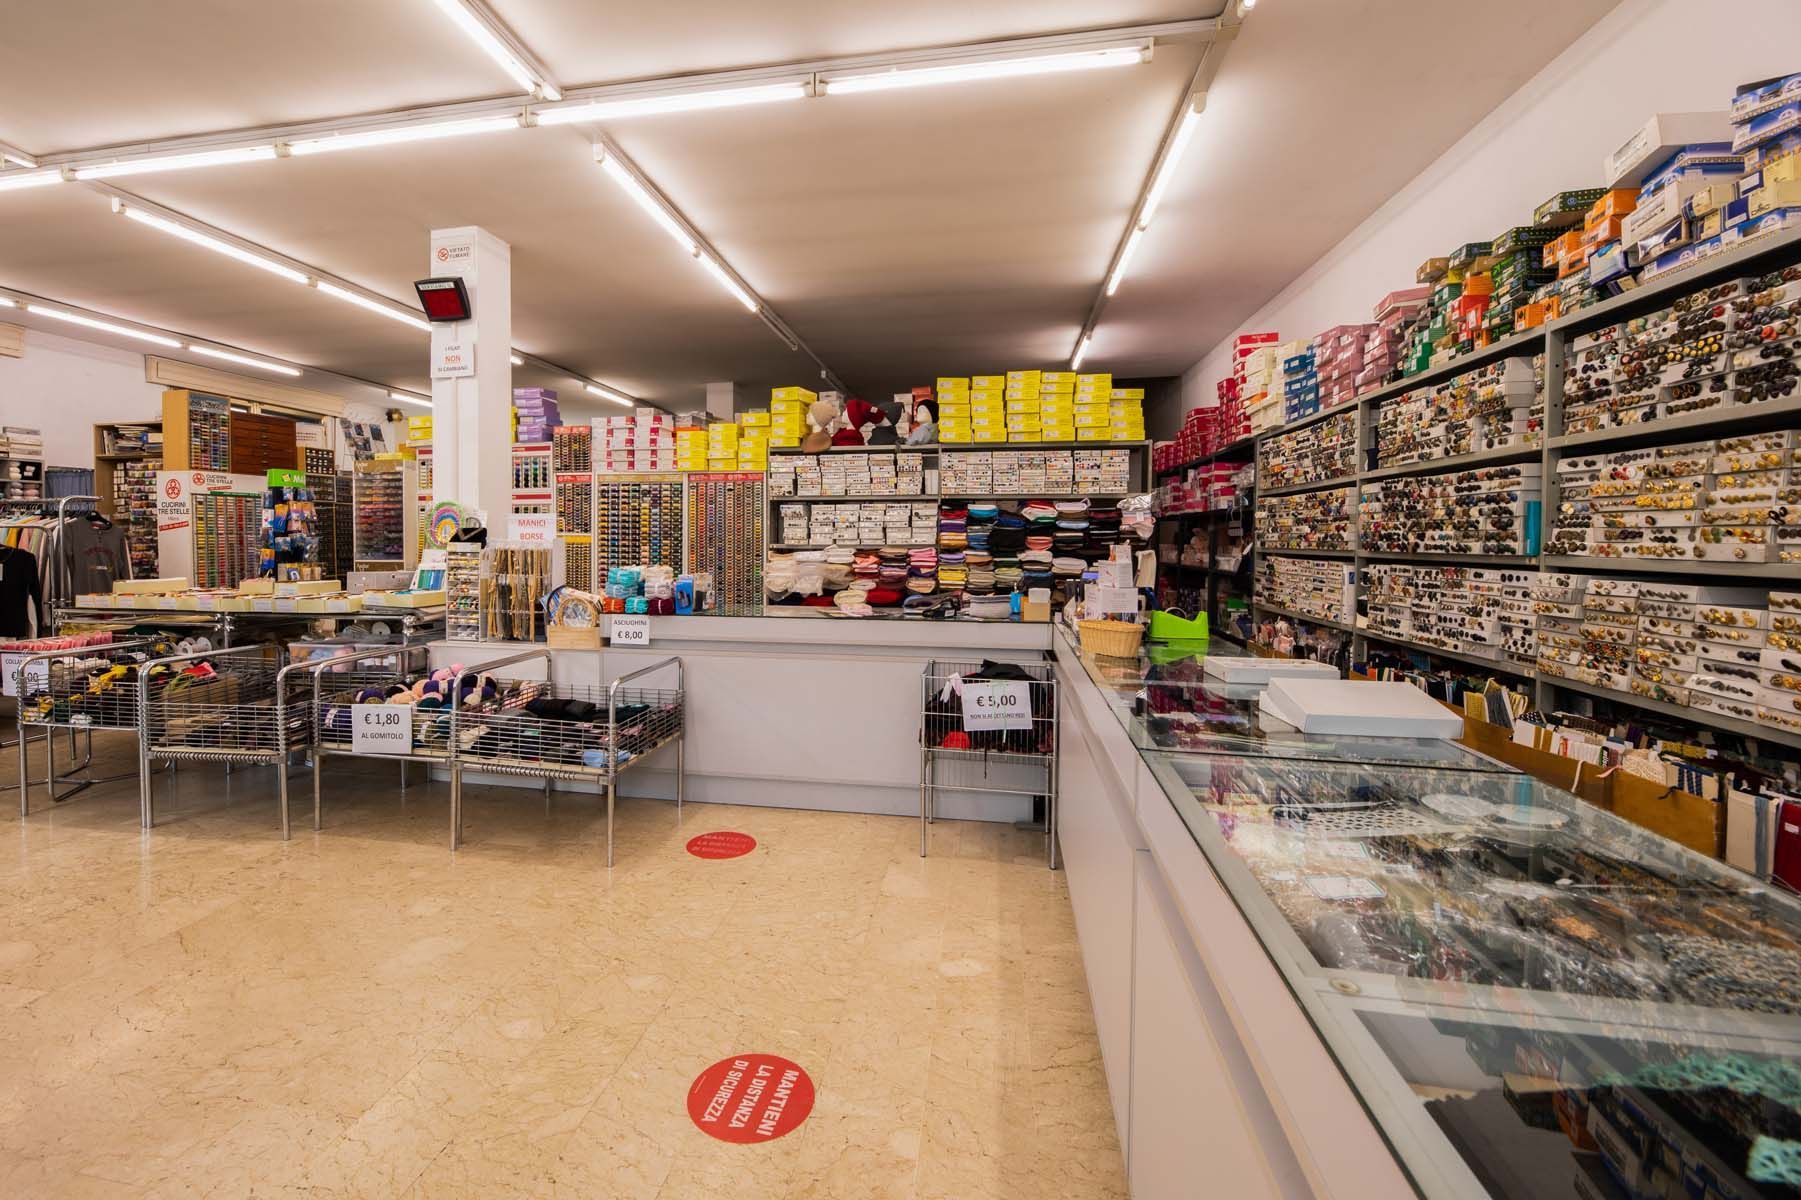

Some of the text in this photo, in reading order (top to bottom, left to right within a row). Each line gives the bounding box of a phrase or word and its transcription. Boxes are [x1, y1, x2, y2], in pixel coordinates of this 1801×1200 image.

[518, 519, 546, 527] MANICI
[618, 630, 643, 641] € 8,00
[976, 695, 1017, 709] € 5,00
[364, 713, 400, 727] € 1,80
[370, 732, 404, 740] GOMITOLO
[701, 1060, 750, 1122] DI SICUREZZA
[728, 1064, 775, 1128] LA DISTANZA
[756, 1069, 800, 1136] MANTIENI
